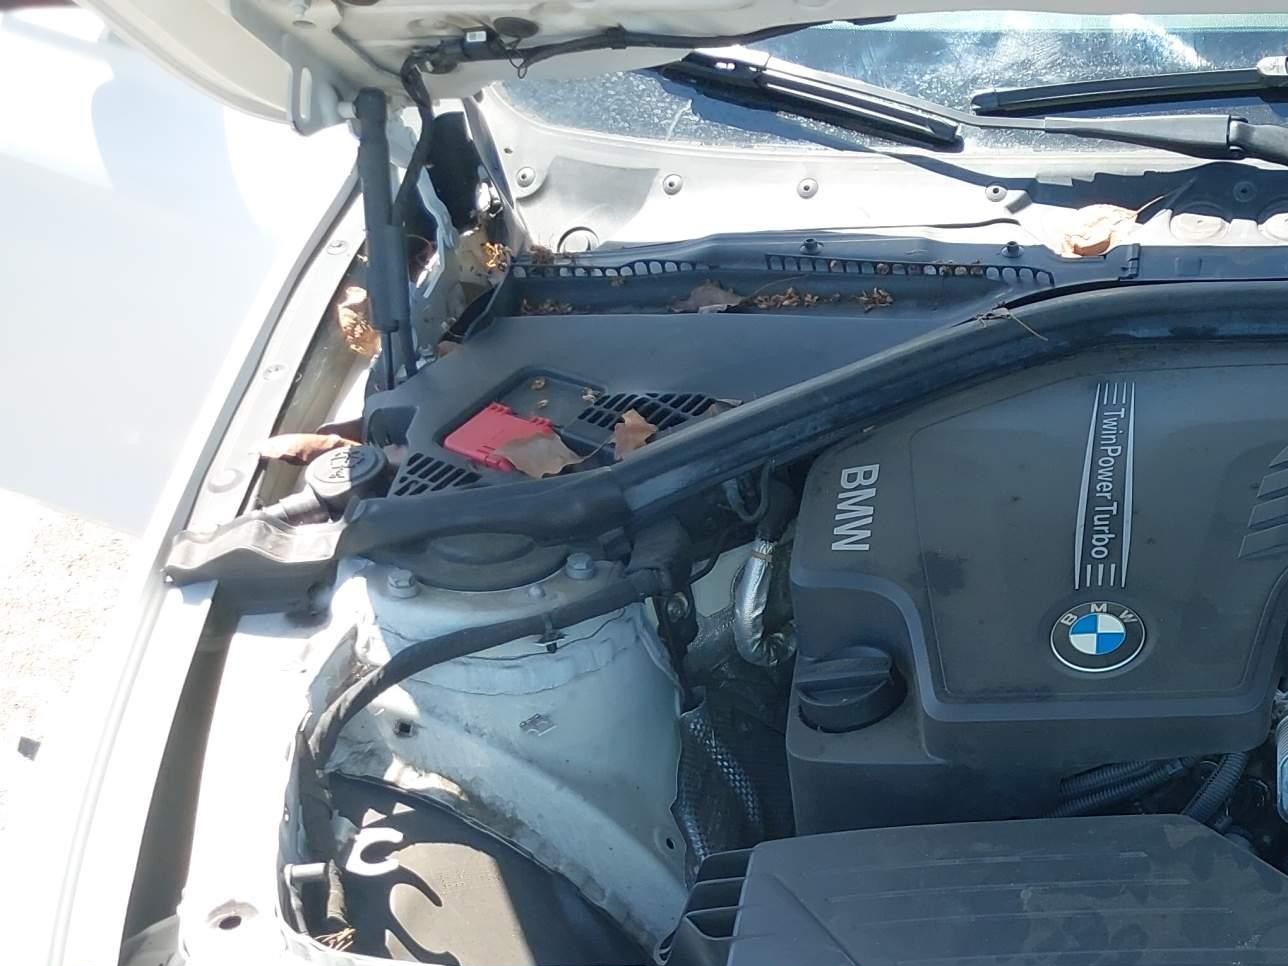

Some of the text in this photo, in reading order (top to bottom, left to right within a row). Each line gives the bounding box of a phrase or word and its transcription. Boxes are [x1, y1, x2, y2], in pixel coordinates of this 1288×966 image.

[831, 463, 880, 551] BMW
[1091, 408, 1125, 559] TwinPower Turbo
[1060, 603, 1138, 626] BMW
